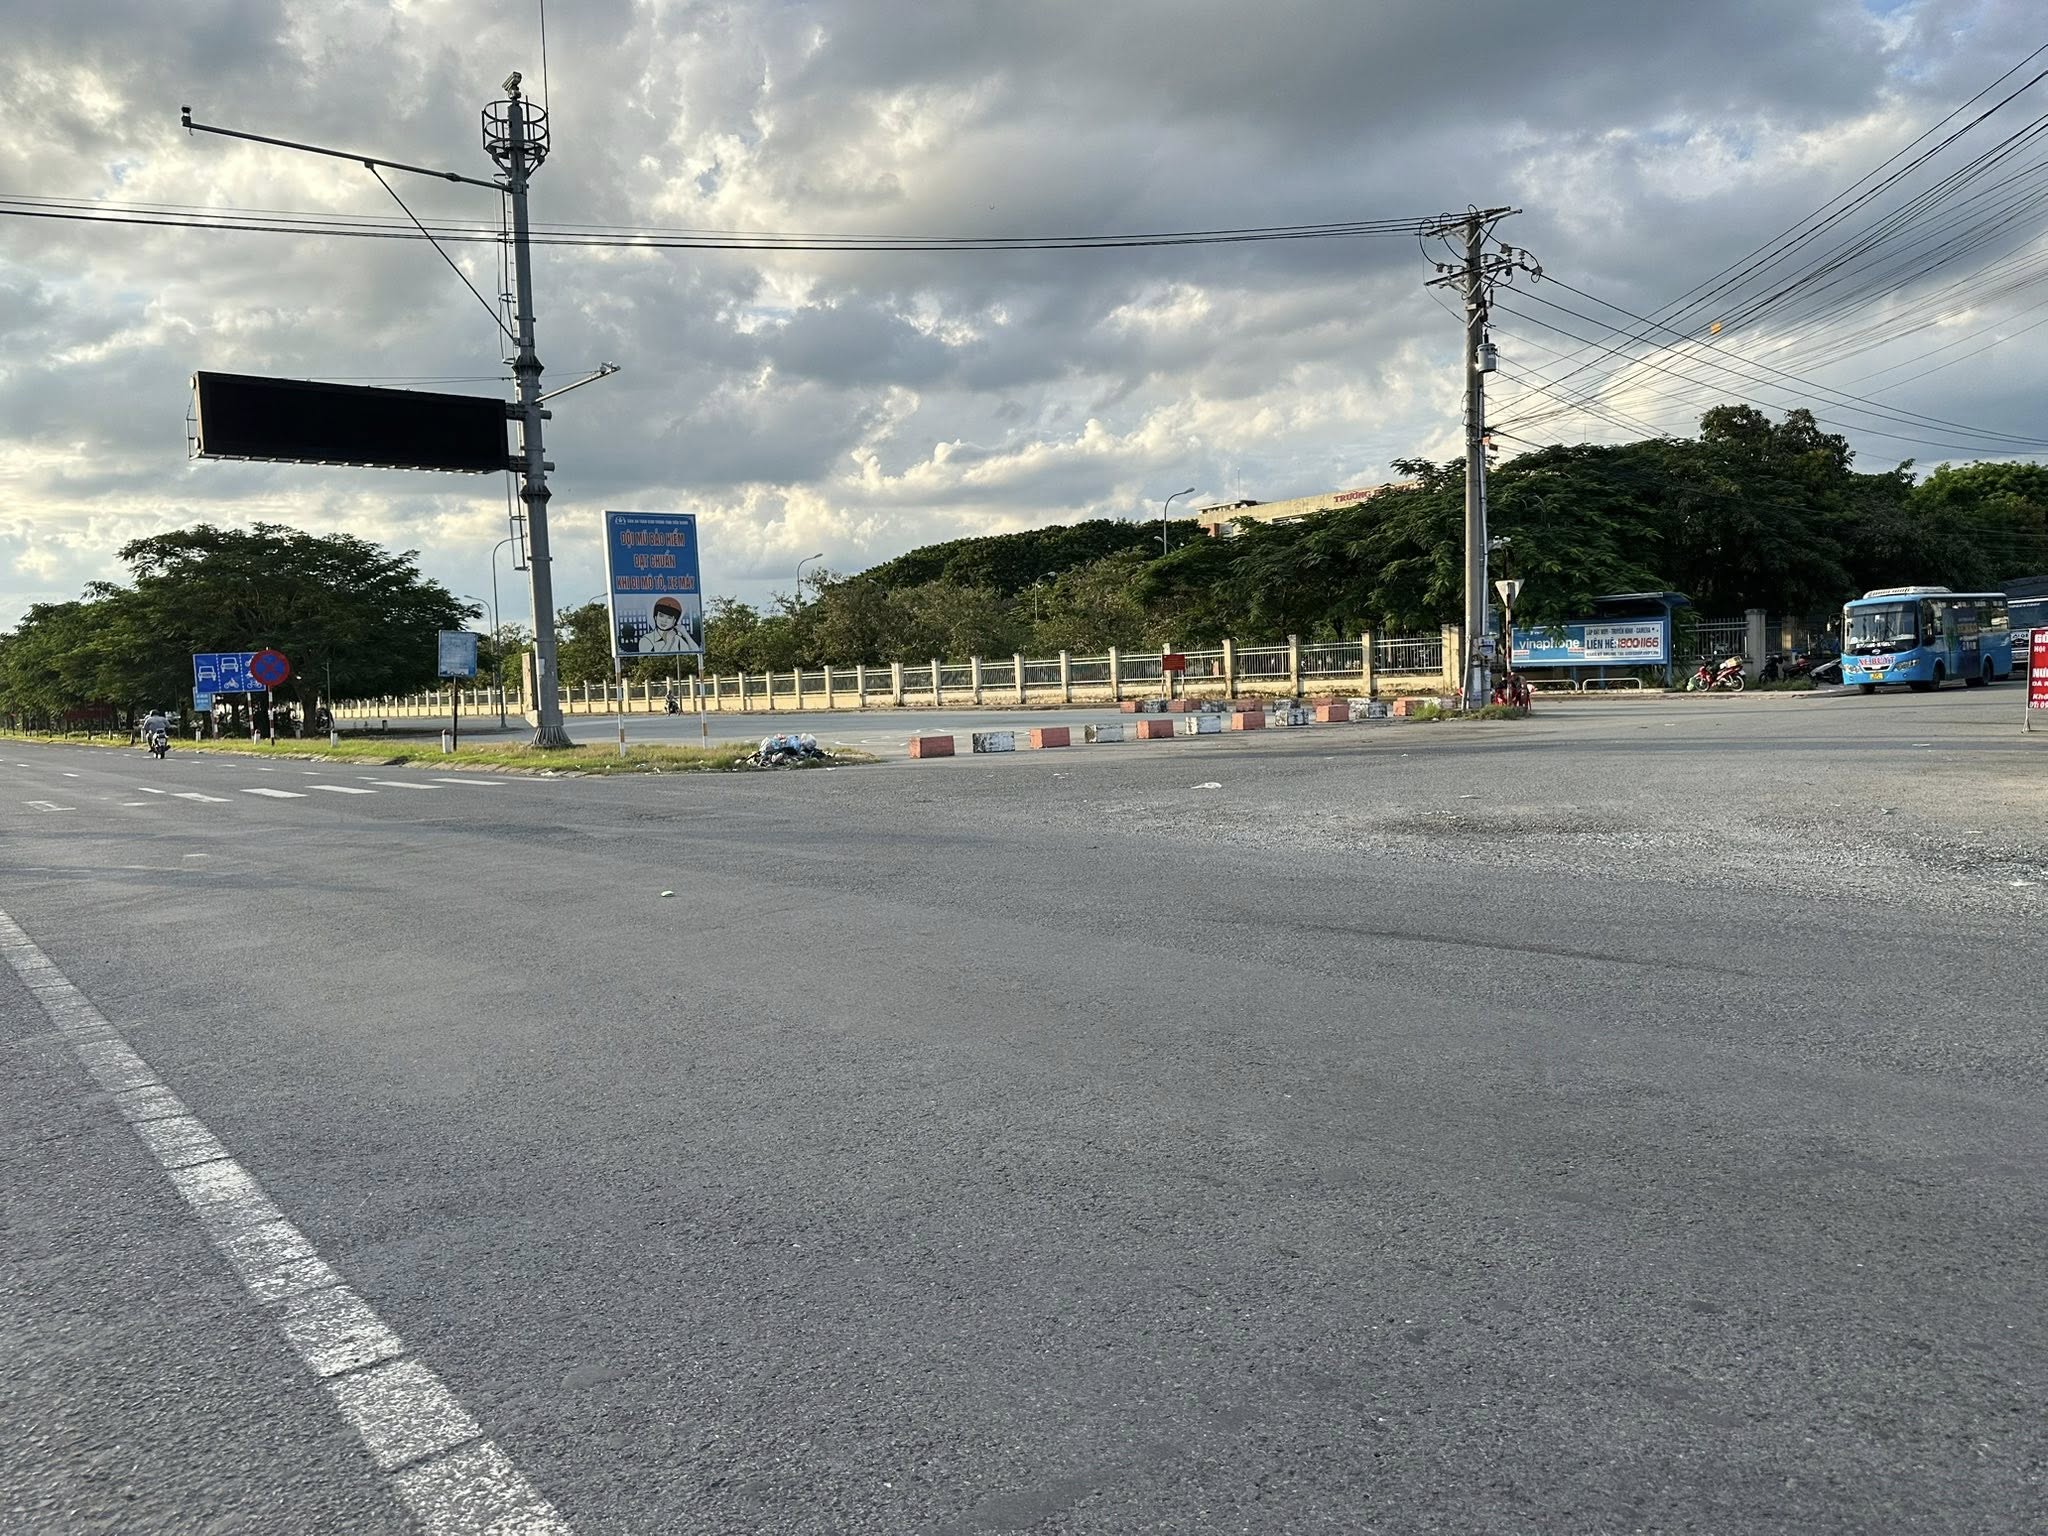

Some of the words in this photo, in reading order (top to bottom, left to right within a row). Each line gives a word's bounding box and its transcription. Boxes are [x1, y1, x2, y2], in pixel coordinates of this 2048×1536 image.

[620, 529, 635, 549] ĐỘI
[666, 528, 686, 547] HIỂM
[634, 554, 649, 571] ĐẠT
[650, 550, 677, 569] CHUẨN
[668, 576, 679, 590] XE
[1586, 637, 1603, 650] LIÊN
